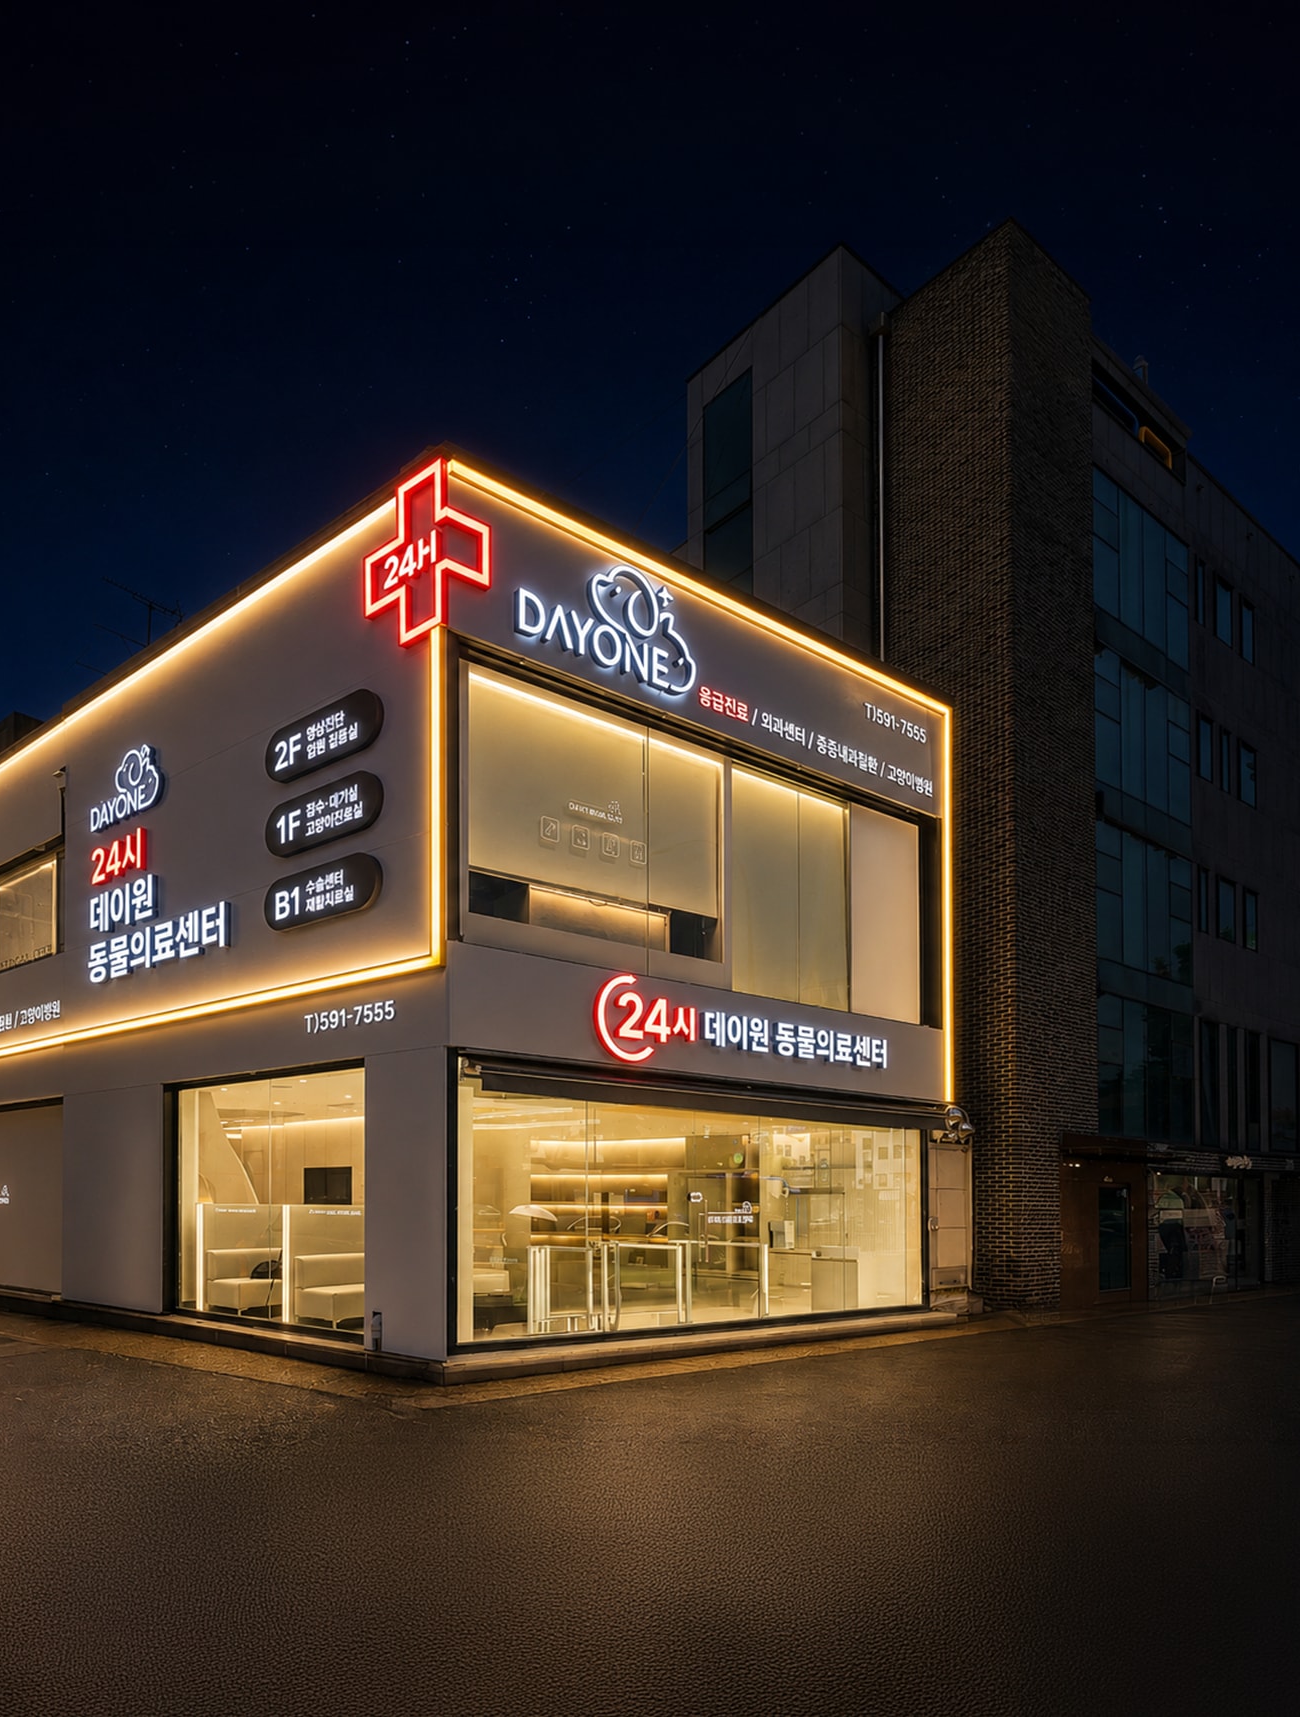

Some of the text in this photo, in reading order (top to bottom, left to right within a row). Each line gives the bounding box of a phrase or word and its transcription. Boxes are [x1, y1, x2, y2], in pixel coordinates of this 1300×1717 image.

[383, 529, 436, 590] 24H
[515, 586, 670, 690] DAYONE
[699, 686, 749, 722] 응급진료
[761, 711, 805, 746] 외과센터
[864, 702, 927, 744] T)591-7555
[274, 732, 302, 772] 2F
[90, 784, 146, 832] DAYONE
[276, 808, 301, 844] 1F
[91, 827, 143, 885] 24시
[305, 868, 344, 896] 수술센터
[90, 874, 153, 932] 데이원
[274, 886, 300, 922] B1
[88, 901, 226, 984] 동물의료센터
[303, 1000, 396, 1034] T)591-7555
[618, 991, 888, 1069] 24시 데이원 동물의료센터
